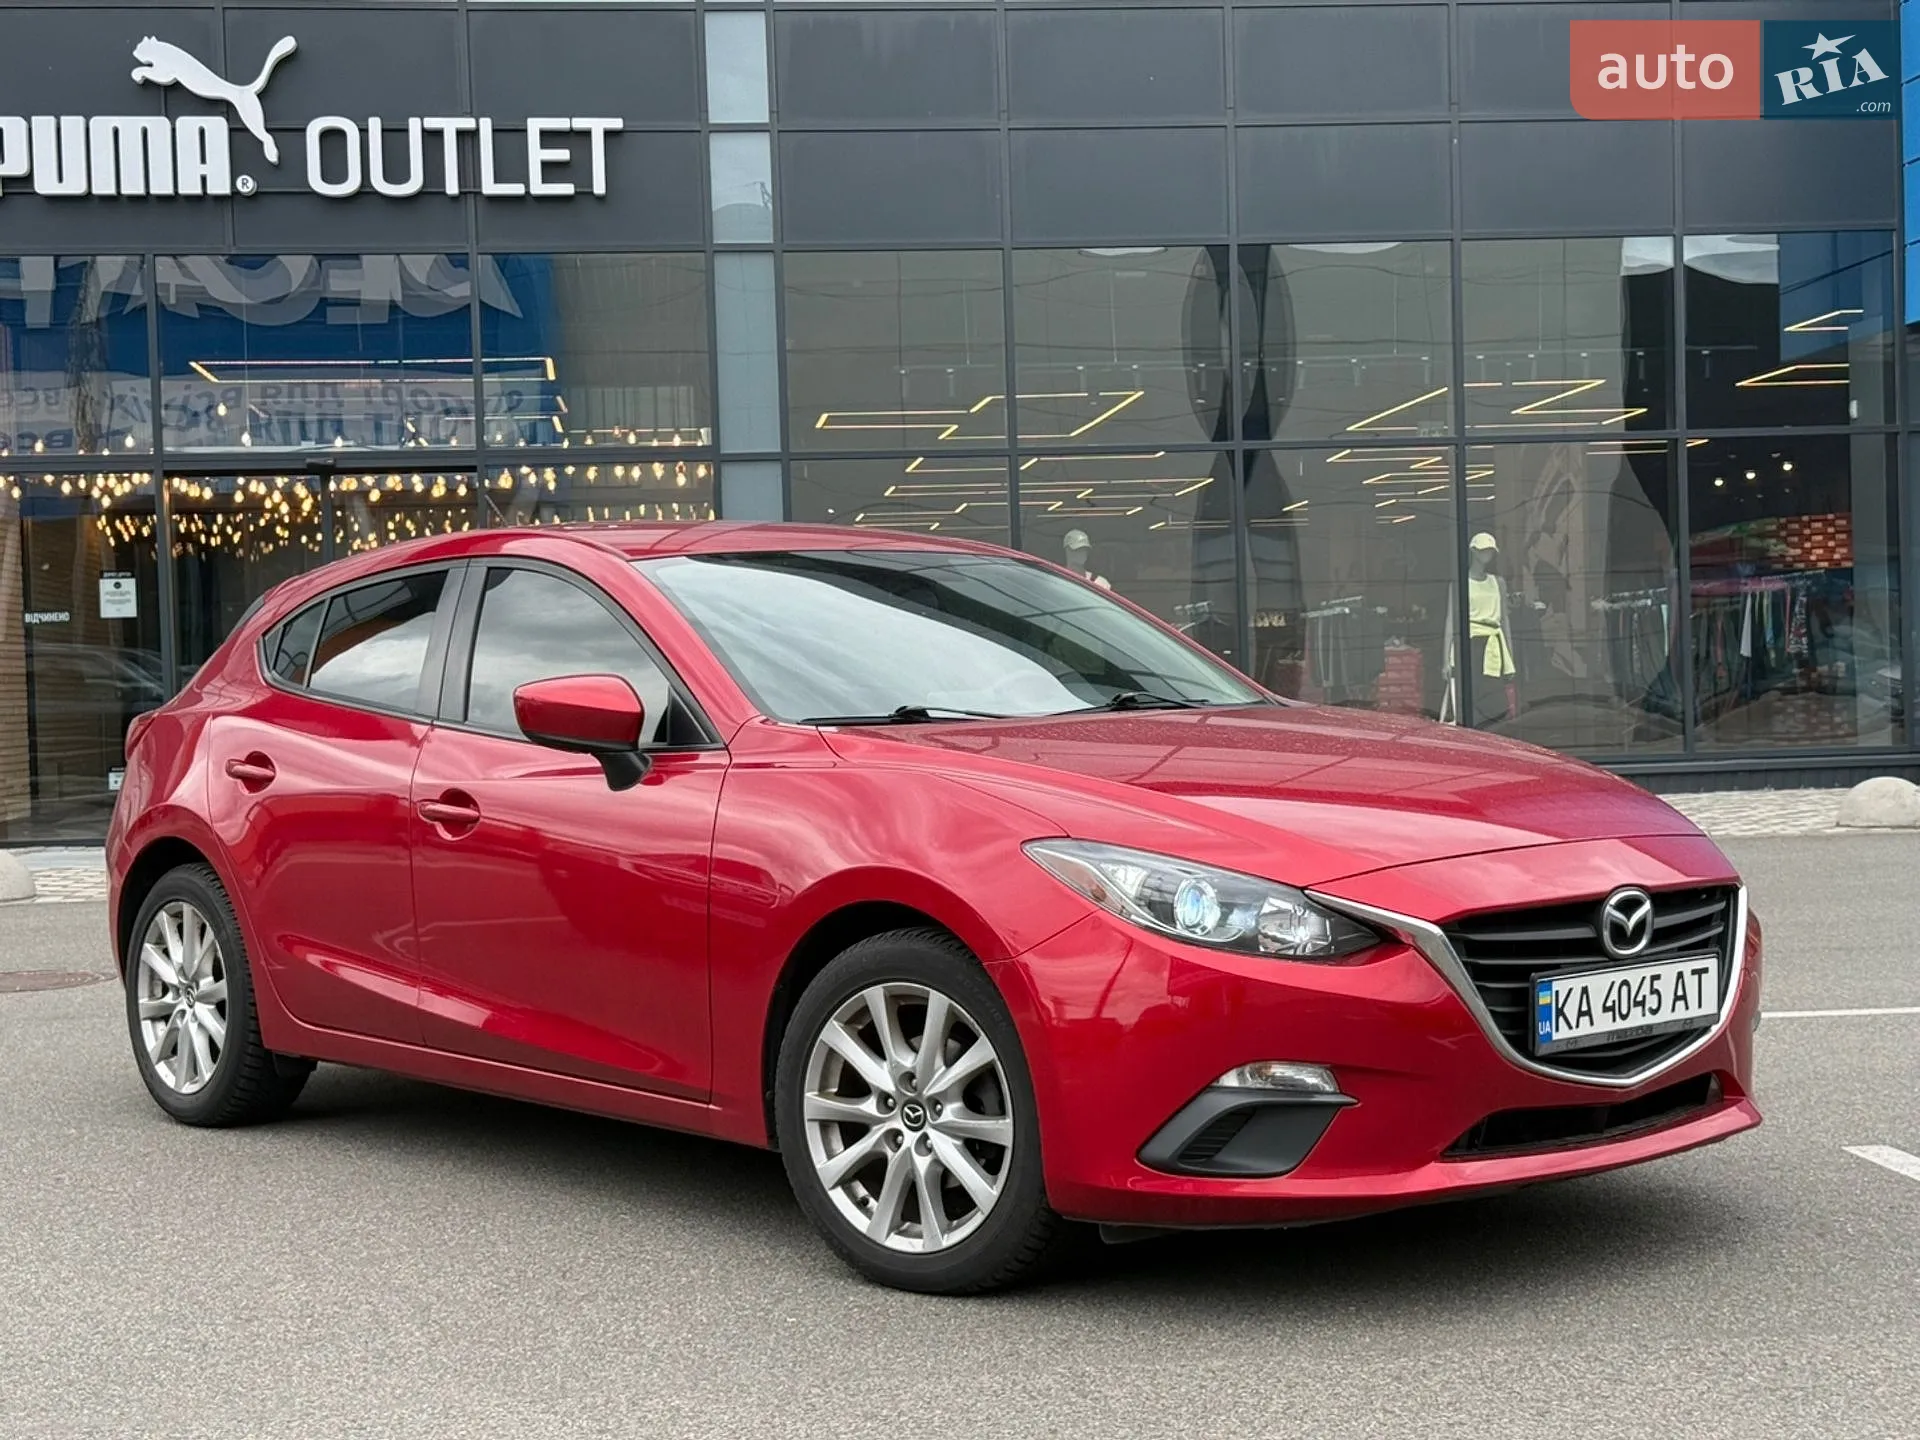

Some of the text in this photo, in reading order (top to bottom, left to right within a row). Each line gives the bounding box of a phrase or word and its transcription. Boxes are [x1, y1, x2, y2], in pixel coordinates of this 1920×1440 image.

[0, 115, 231, 196] PUMA
[306, 117, 623, 197] OUTLET
[1538, 1021, 1552, 1035] UA
[1555, 967, 1710, 1032] KA 4045 AT
